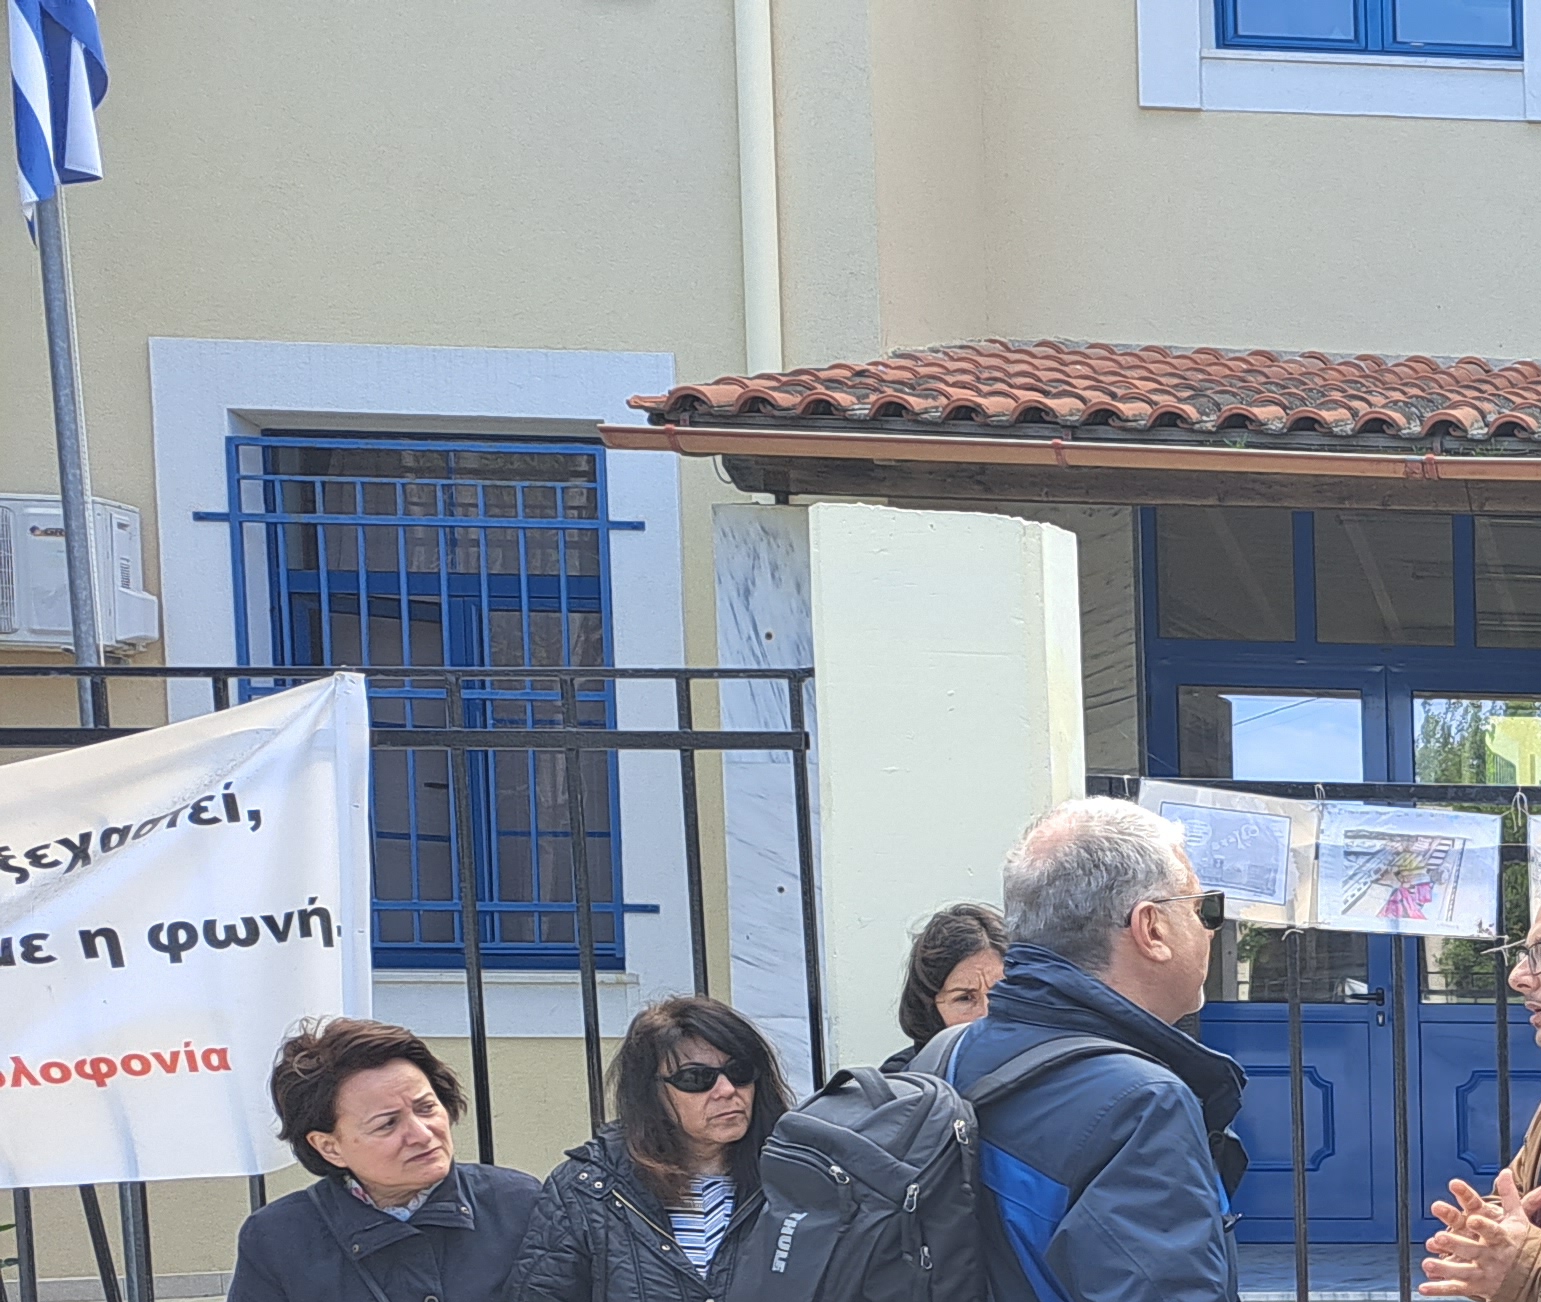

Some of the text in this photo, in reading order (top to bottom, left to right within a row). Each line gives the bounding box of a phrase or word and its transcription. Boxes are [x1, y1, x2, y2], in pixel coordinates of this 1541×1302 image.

[78, 926, 126, 969] η
[0, 1041, 232, 1088] λοφονία
[771, 1212, 808, 1273] THULE
